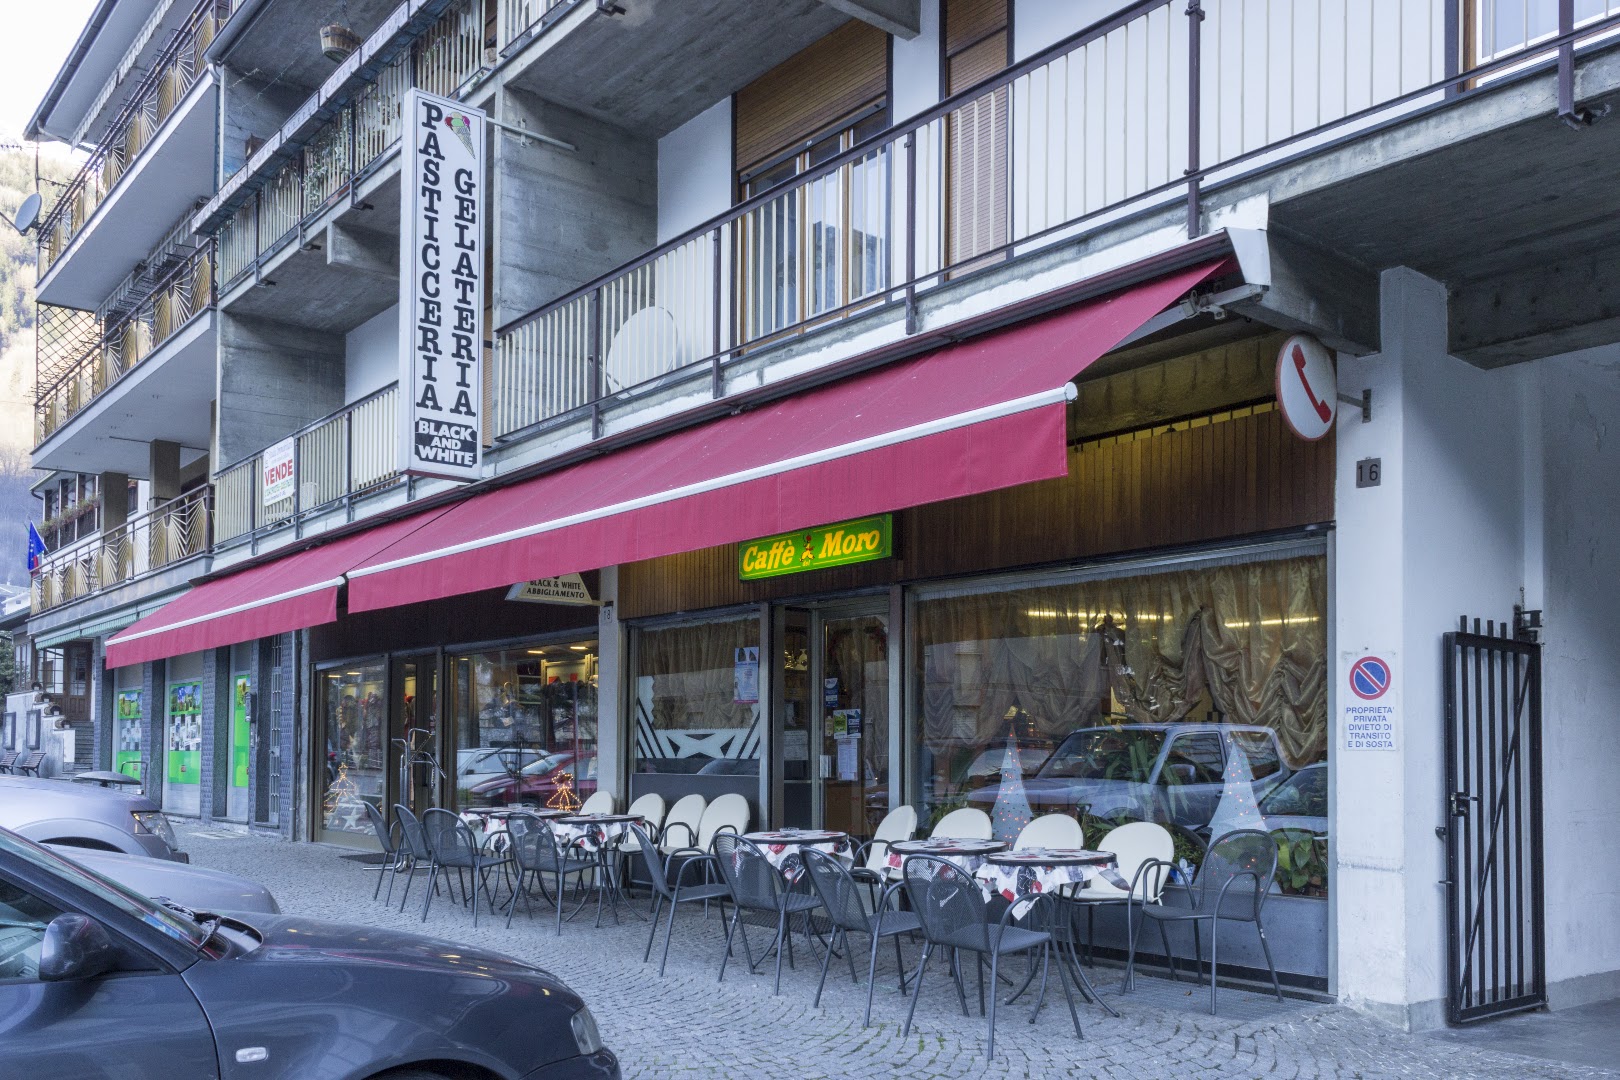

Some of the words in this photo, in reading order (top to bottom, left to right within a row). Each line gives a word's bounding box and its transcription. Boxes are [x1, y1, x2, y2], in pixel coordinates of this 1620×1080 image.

[416, 101, 446, 412] PASTICCERIA
[449, 168, 478, 418] GELATERIA
[418, 420, 473, 442] BLACK
[430, 437, 462, 451] AND
[417, 445, 474, 466] WHITE
[264, 458, 294, 487] VENDE
[1358, 463, 1379, 482] 16
[742, 539, 795, 572] Caffè
[818, 529, 881, 559] Moro
[526, 587, 585, 599] ABBIGLIAMENTO
[529, 579, 552, 588] BLACK
[553, 580, 560, 589] &
[561, 581, 581, 590] WHITE
[1346, 706, 1394, 714] PROPRIETA'
[1353, 715, 1387, 723] PRIVATA
